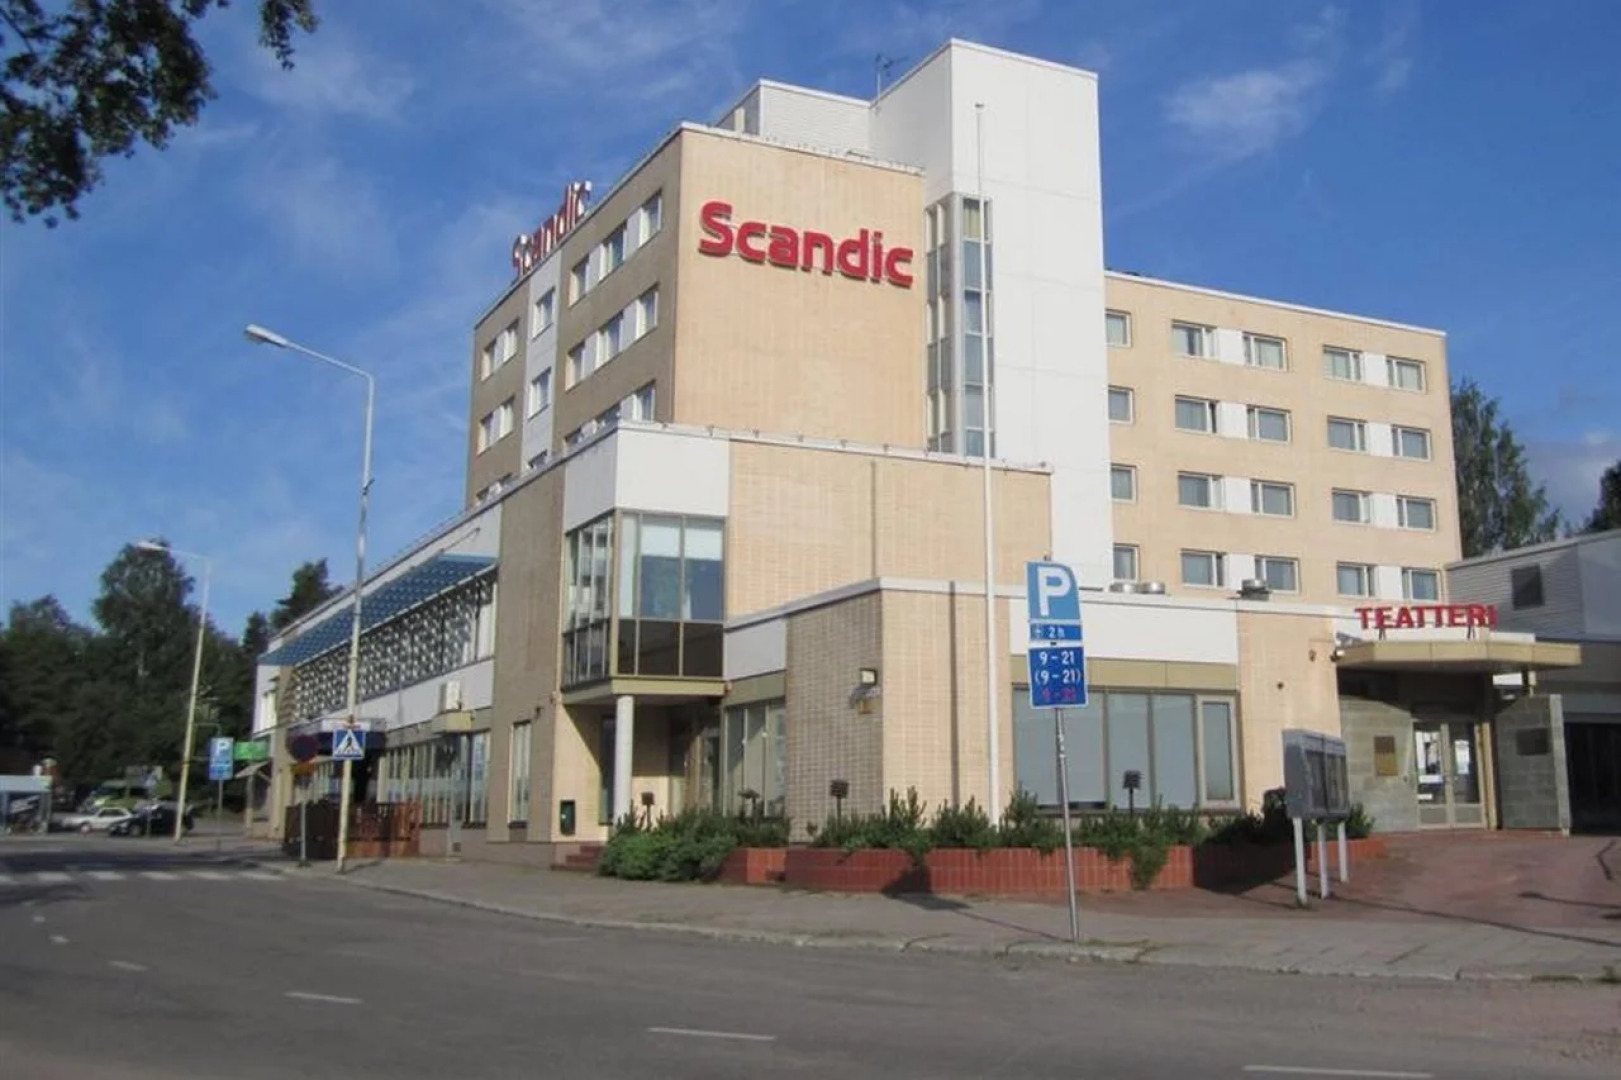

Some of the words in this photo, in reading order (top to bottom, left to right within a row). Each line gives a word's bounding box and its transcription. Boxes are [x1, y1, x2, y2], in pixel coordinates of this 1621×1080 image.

[700, 201, 914, 287] Scandic
[1037, 567, 1071, 616] P
[1355, 604, 1497, 629] TEATTERI
